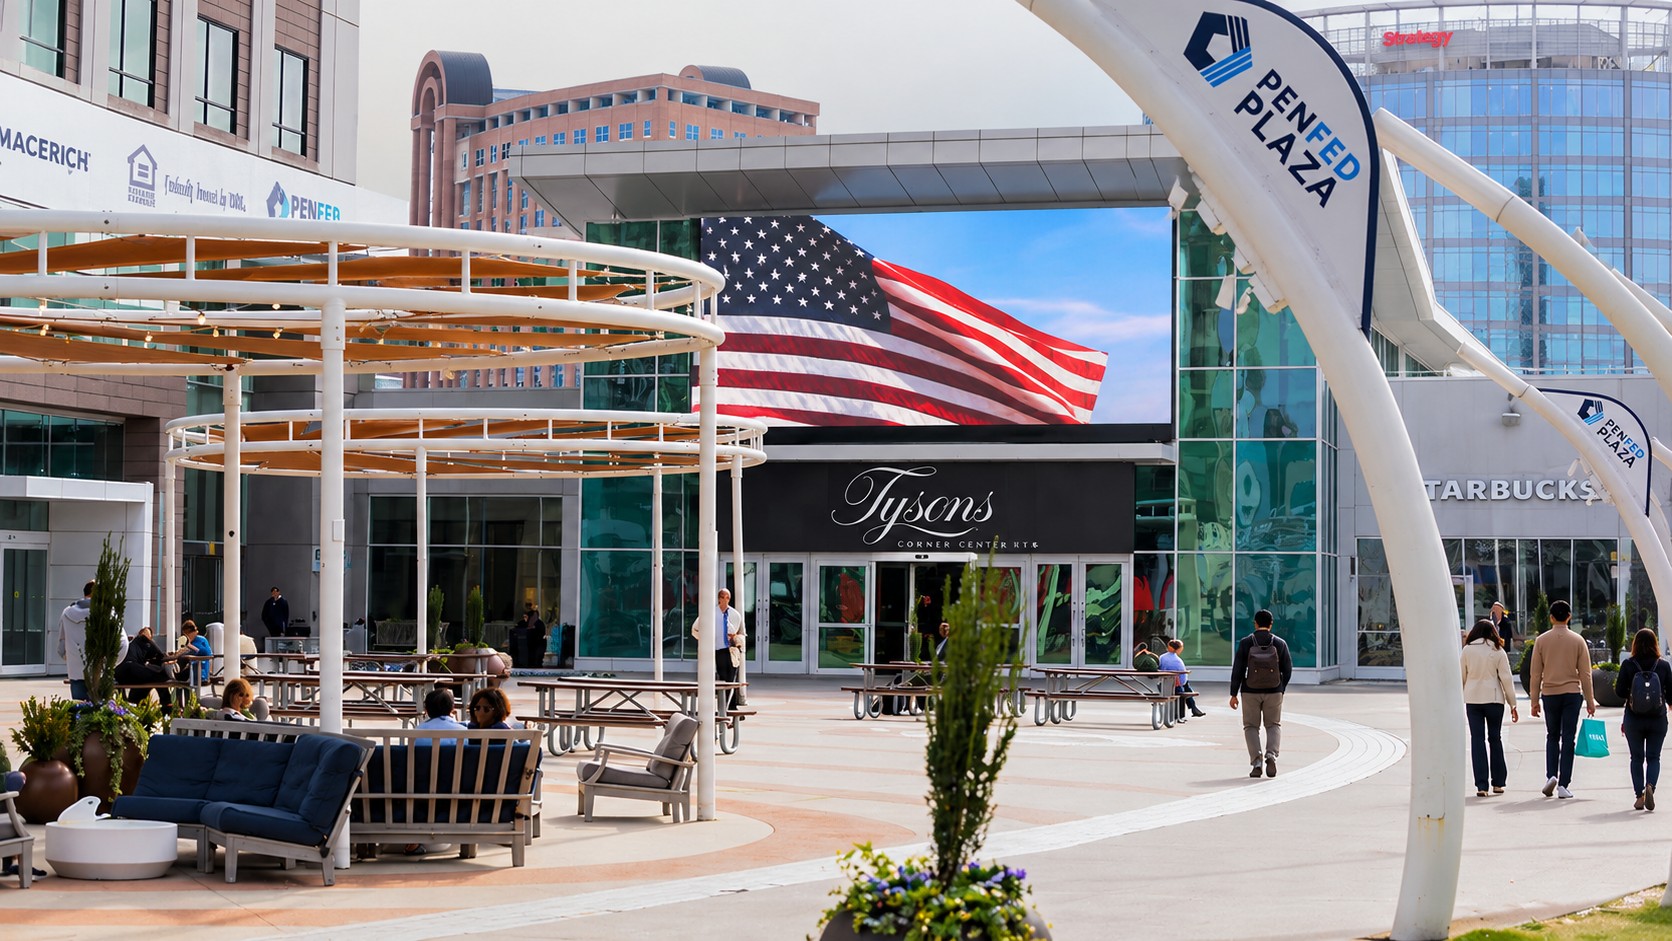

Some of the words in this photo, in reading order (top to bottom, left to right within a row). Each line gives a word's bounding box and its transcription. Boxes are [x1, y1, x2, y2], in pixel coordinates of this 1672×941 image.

[1382, 29, 1454, 48] Strategy
[1256, 68, 1361, 181] PENFED
[0, 126, 89, 172] MACERICH
[1233, 90, 1337, 208] PLAZA
[1596, 426, 1636, 469] PLAZA
[1605, 419, 1645, 459] PENFED
[831, 466, 994, 545] Tysons
[1424, 479, 1598, 501] TARBUCKS
[897, 540, 951, 549] CORNER
[958, 540, 1007, 549] CENTER
